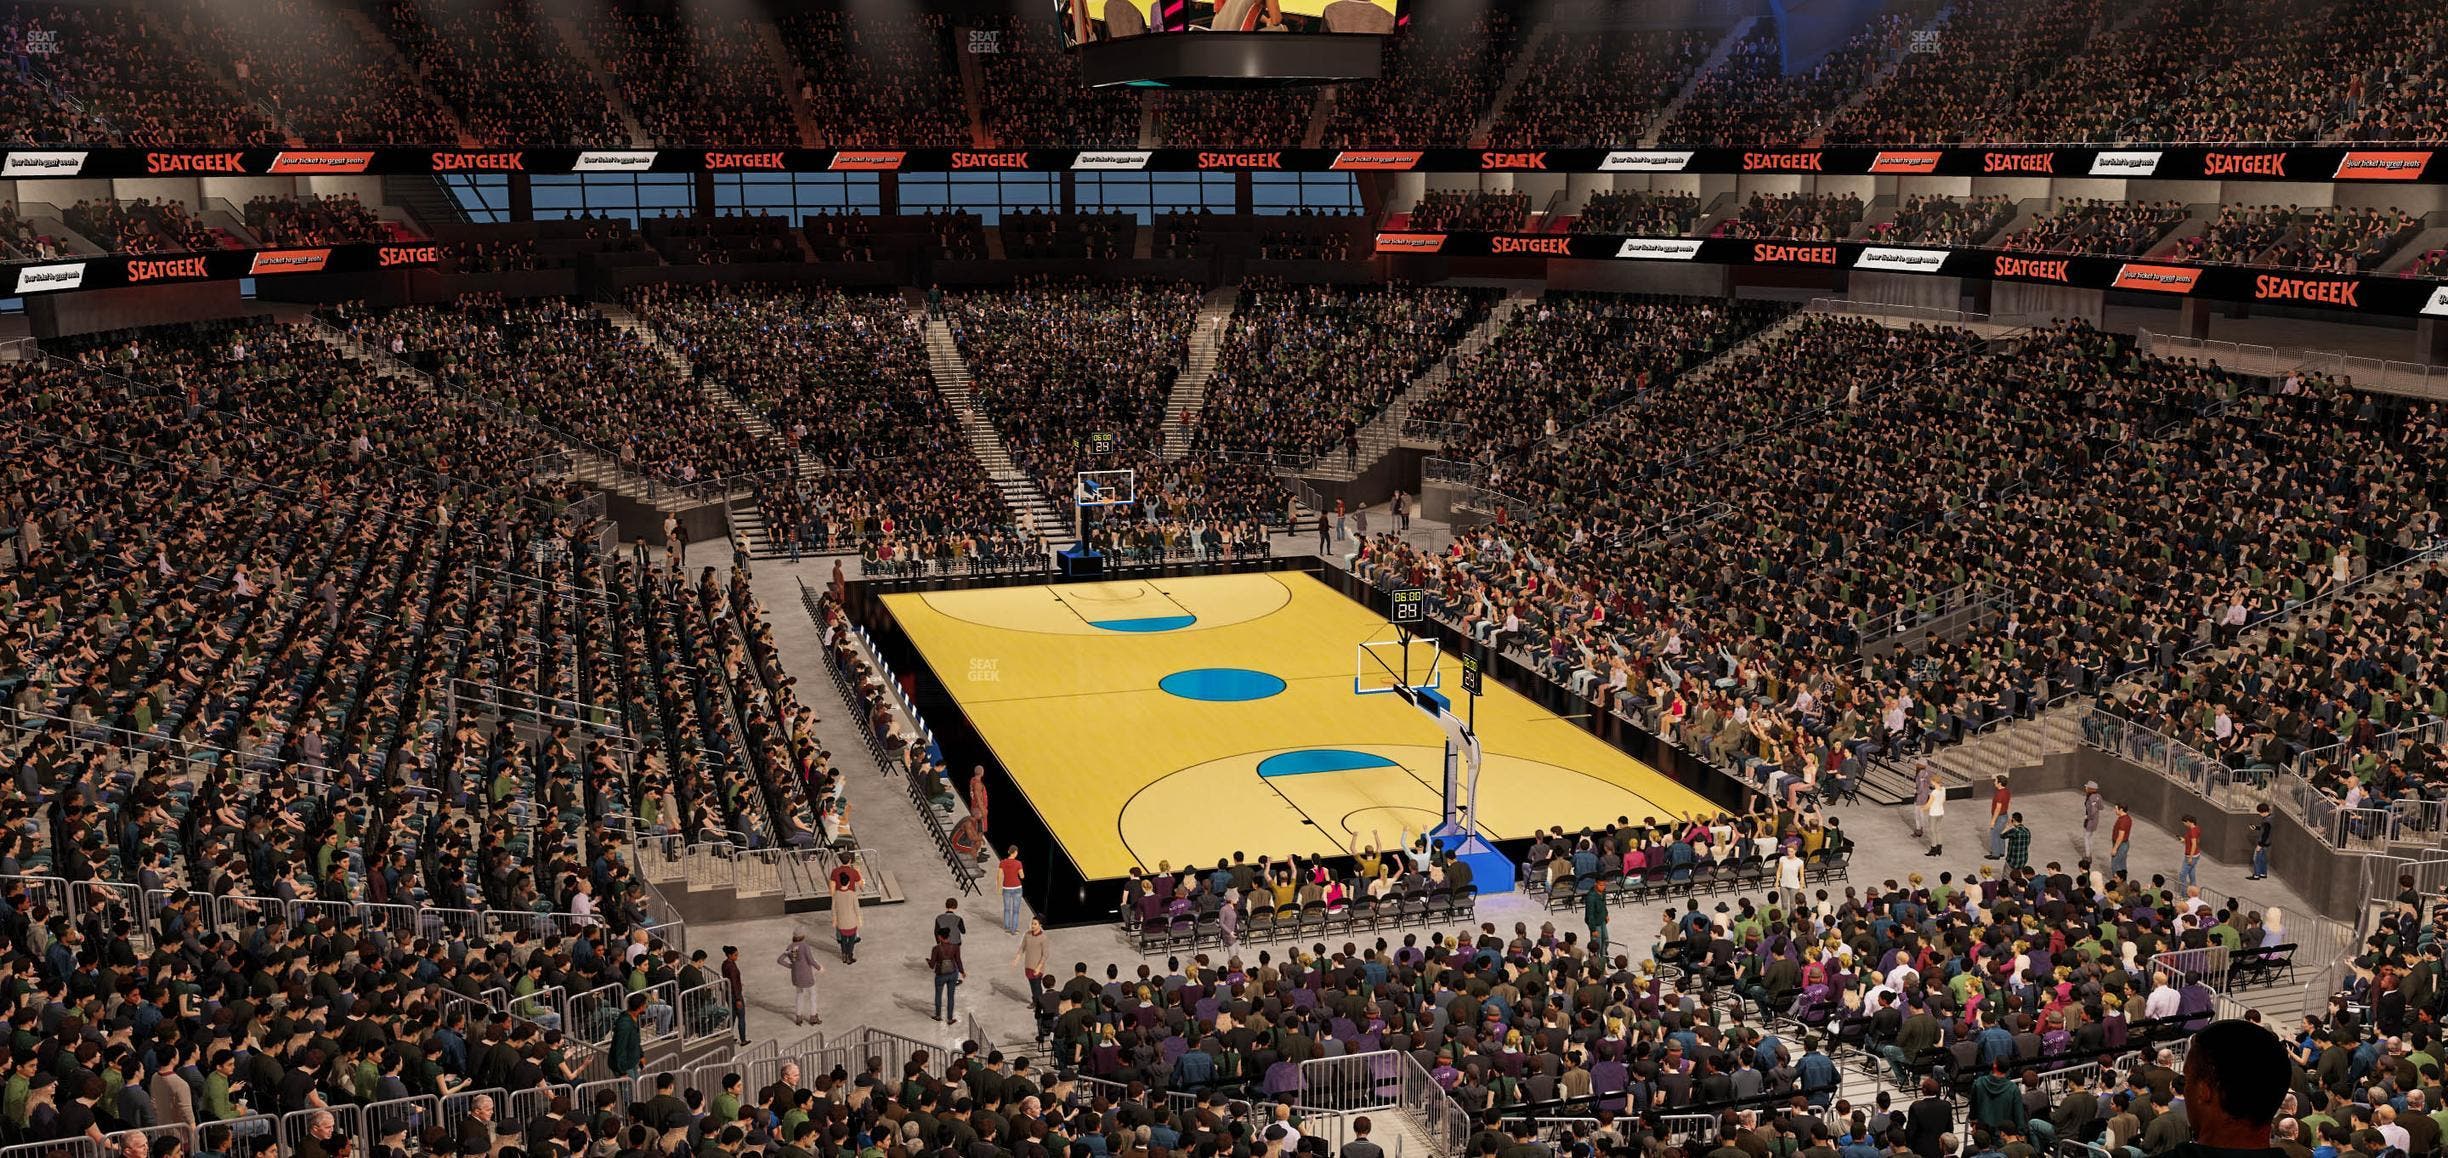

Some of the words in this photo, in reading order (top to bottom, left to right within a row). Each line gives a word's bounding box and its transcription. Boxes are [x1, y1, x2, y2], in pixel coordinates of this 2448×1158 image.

[147, 152, 244, 173] SEATGEEK
[432, 152, 523, 171] SEATGEEK
[706, 152, 784, 169] SEATGEEK
[952, 152, 1027, 168] SEATGEEK
[1199, 152, 1280, 169] SEATGEEK
[1744, 152, 1821, 171] SEATGEEK
[1984, 152, 2052, 172] SEATGEEK
[2205, 153, 2285, 176] SEATGEEK
[2386, 161, 2403, 170] great
[1492, 237, 1569, 255] SEATGEEK
[1754, 244, 1836, 264] SEATGEE
[128, 257, 207, 282] SEATGEEK
[1995, 256, 2067, 281] SEATGEEK
[2255, 275, 2357, 306] SEATGEEK
[1394, 592, 1421, 602] 06:00
[1398, 604, 1417, 618] 24
